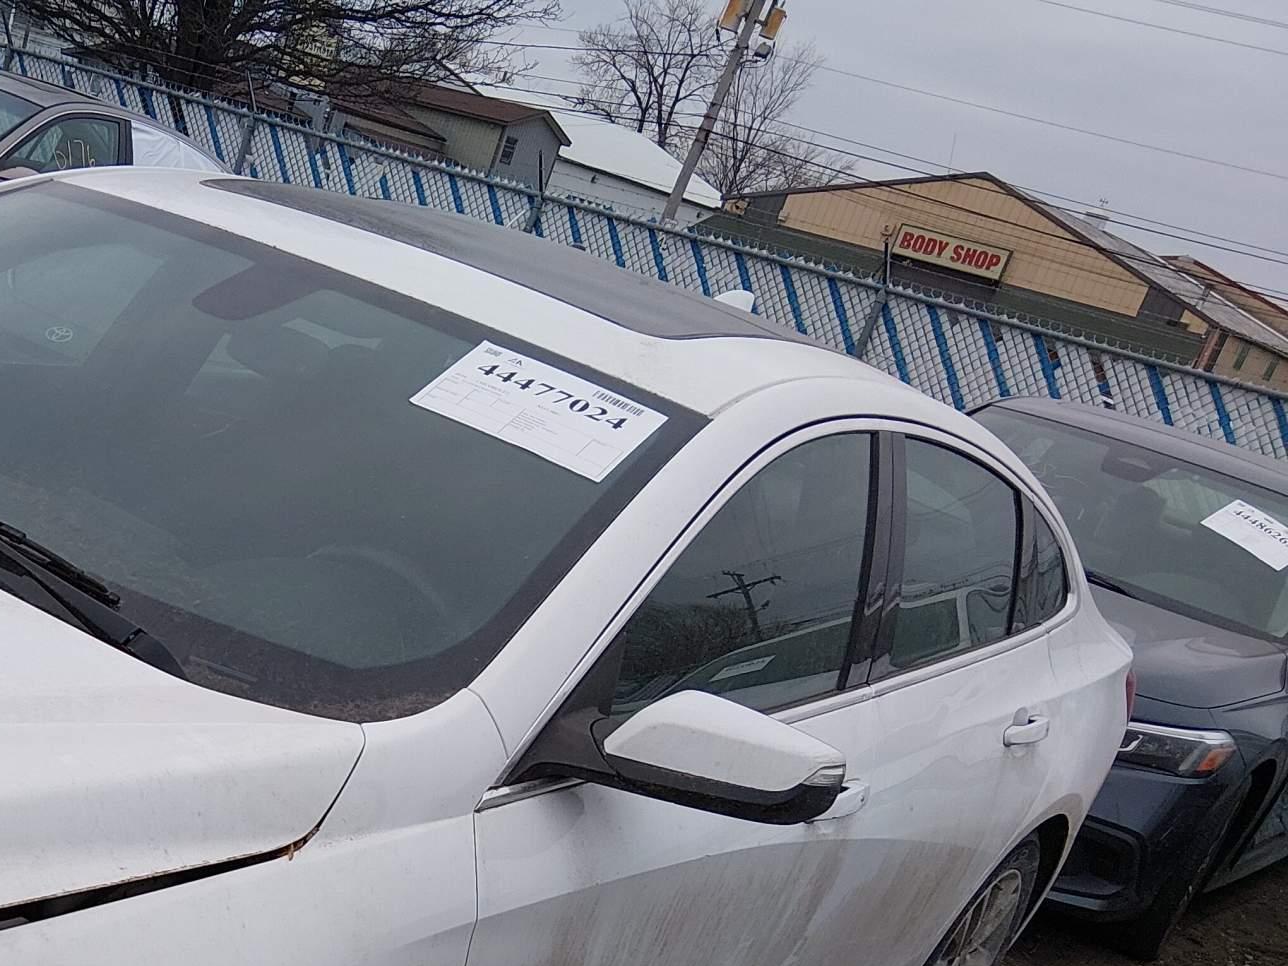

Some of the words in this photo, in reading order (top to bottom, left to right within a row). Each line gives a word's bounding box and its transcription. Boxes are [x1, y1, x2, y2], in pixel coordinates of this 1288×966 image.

[899, 231, 949, 258] BODY
[950, 245, 1001, 271] SHOP
[477, 364, 630, 430] 44477024
